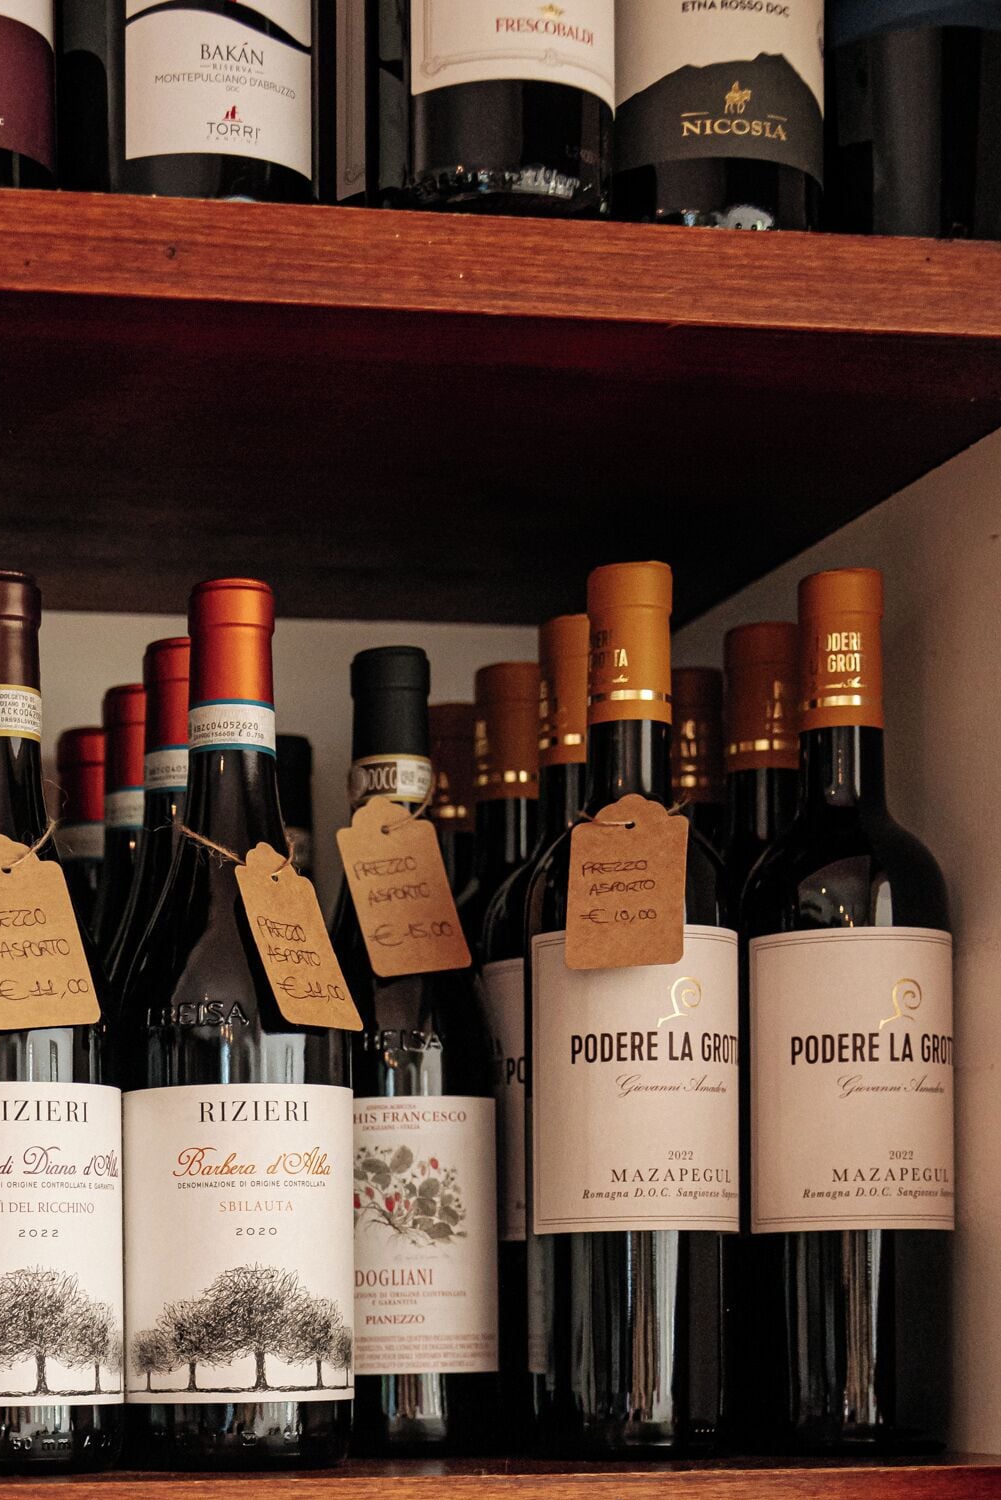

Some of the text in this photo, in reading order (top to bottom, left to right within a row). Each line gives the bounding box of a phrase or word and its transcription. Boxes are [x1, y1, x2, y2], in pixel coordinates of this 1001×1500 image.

[496, 17, 594, 46] FRESCOBALDI
[200, 42, 264, 66] BAKÁN
[212, 63, 252, 74] RISERVA
[154, 72, 296, 100] MONTEPULCIANO D'ABRUZZO
[680, 118, 787, 141] NICOSIA
[353, 856, 416, 880] PREZZO
[582, 859, 648, 877] PREZZO
[589, 879, 655, 896] ASPORTO
[580, 909, 657, 923] € 10,00
[257, 916, 306, 942] PREZZO
[267, 944, 320, 966] ASPORTO
[30, 978, 89, 999] 11,00
[277, 977, 305, 999] €
[571, 1031, 658, 1064] PODERE
[669, 1031, 693, 1061] LA
[791, 1032, 879, 1065] PODERE
[890, 1032, 913, 1062] LA
[199, 1100, 309, 1123] RIZIERI
[383, 1111, 467, 1122] FRANCESCO
[23, 1145, 77, 1175] Diano
[172, 1146, 331, 1176] Barbera d'Alba
[668, 1151, 694, 1160] 2022
[889, 1151, 914, 1160] 2022
[6, 1181, 38, 1189] ORIGINE
[41, 1181, 86, 1189] CONTROLLATA
[177, 1180, 236, 1190] DENOMINAZIONE
[250, 1180, 281, 1188] ORIGINE
[283, 1180, 326, 1188] CONTROLLATA
[582, 1189, 629, 1200] Romagna
[634, 1188, 671, 1198] D.O.C.
[802, 1188, 850, 1200] Romagna
[855, 1187, 892, 1197] D.O.C.
[9, 1202, 34, 1213] DEL
[38, 1202, 95, 1214] RICCHINO
[219, 1200, 294, 1213] SBILAUTA
[18, 1229, 60, 1238] 2022
[235, 1227, 278, 1236] 2020
[355, 1269, 433, 1287] DOGLIANI
[365, 1314, 425, 1325] PIANEZZO
